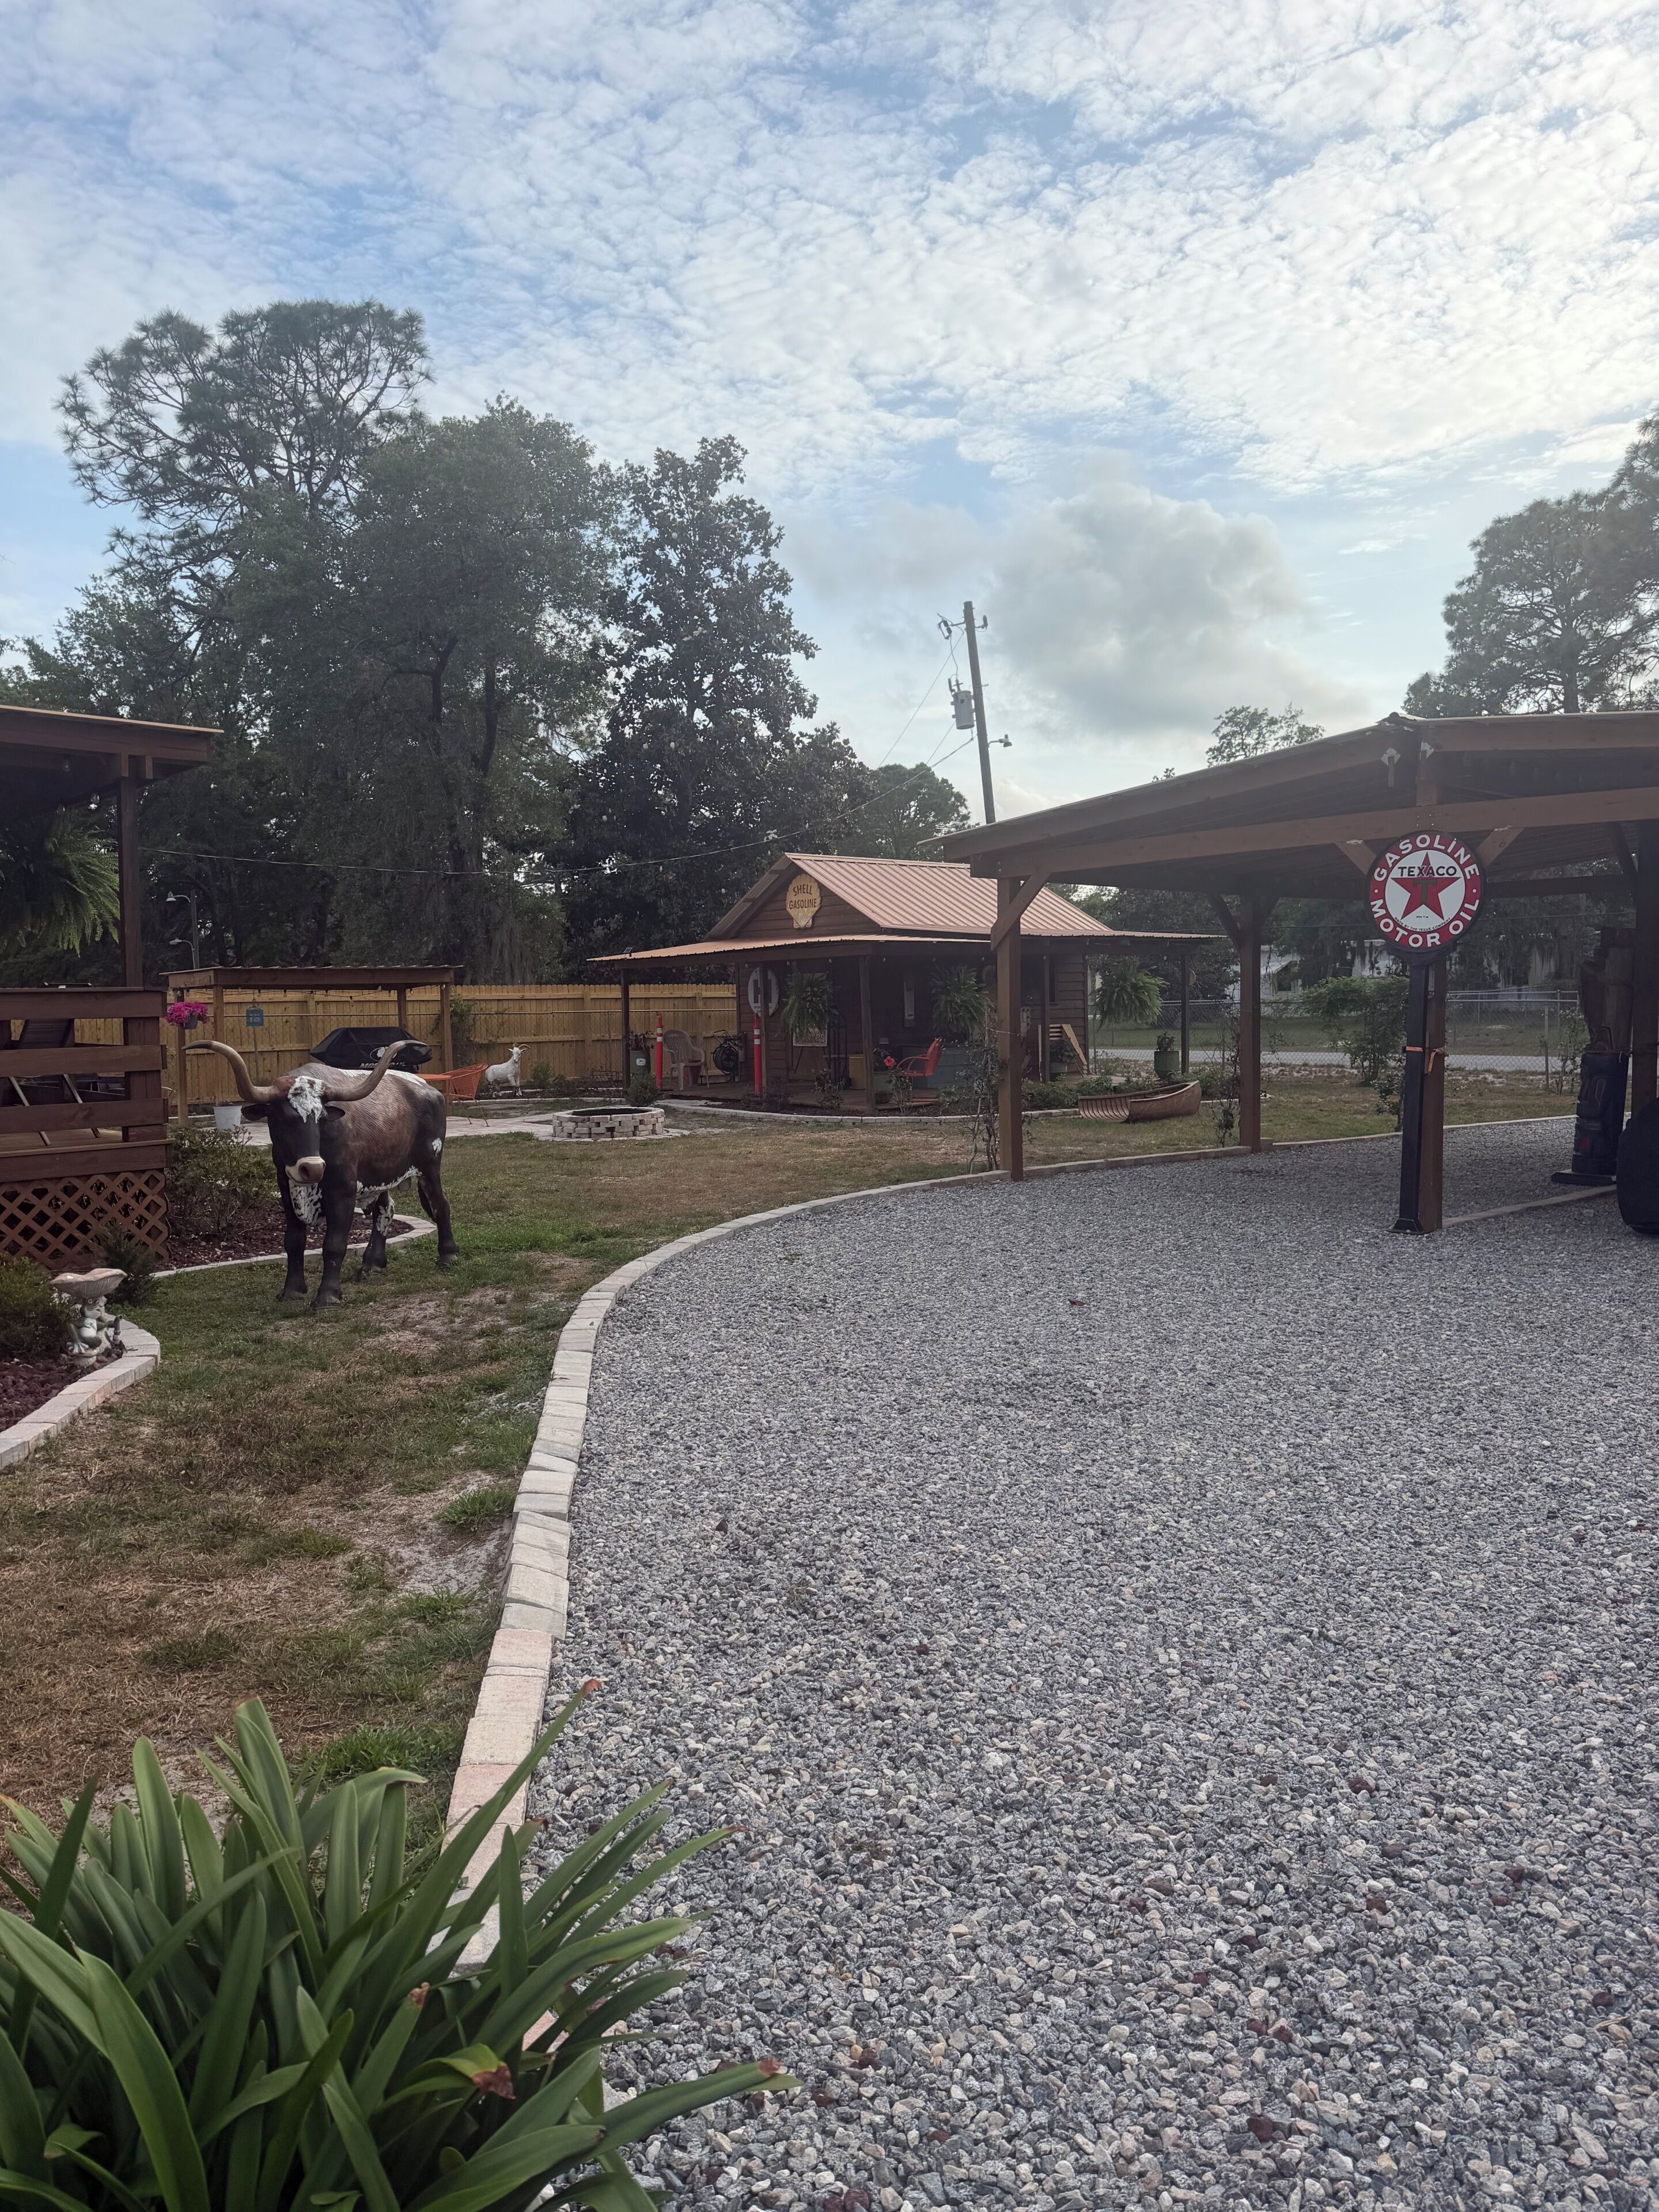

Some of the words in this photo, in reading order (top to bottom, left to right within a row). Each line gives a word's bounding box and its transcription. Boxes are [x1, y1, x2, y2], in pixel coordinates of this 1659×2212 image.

[1374, 834, 1479, 881] GASOLINE
[1397, 866, 1457, 877] TEXACO
[793, 884, 812, 896] SHELL
[1413, 879, 1437, 905] T
[789, 899, 816, 910] GASOLINE
[1370, 899, 1441, 948] MOTOR
[1449, 899, 1479, 935] OIL
[1395, 916, 1404, 926] MADE
[1432, 917, 1450, 929] COMPANY
